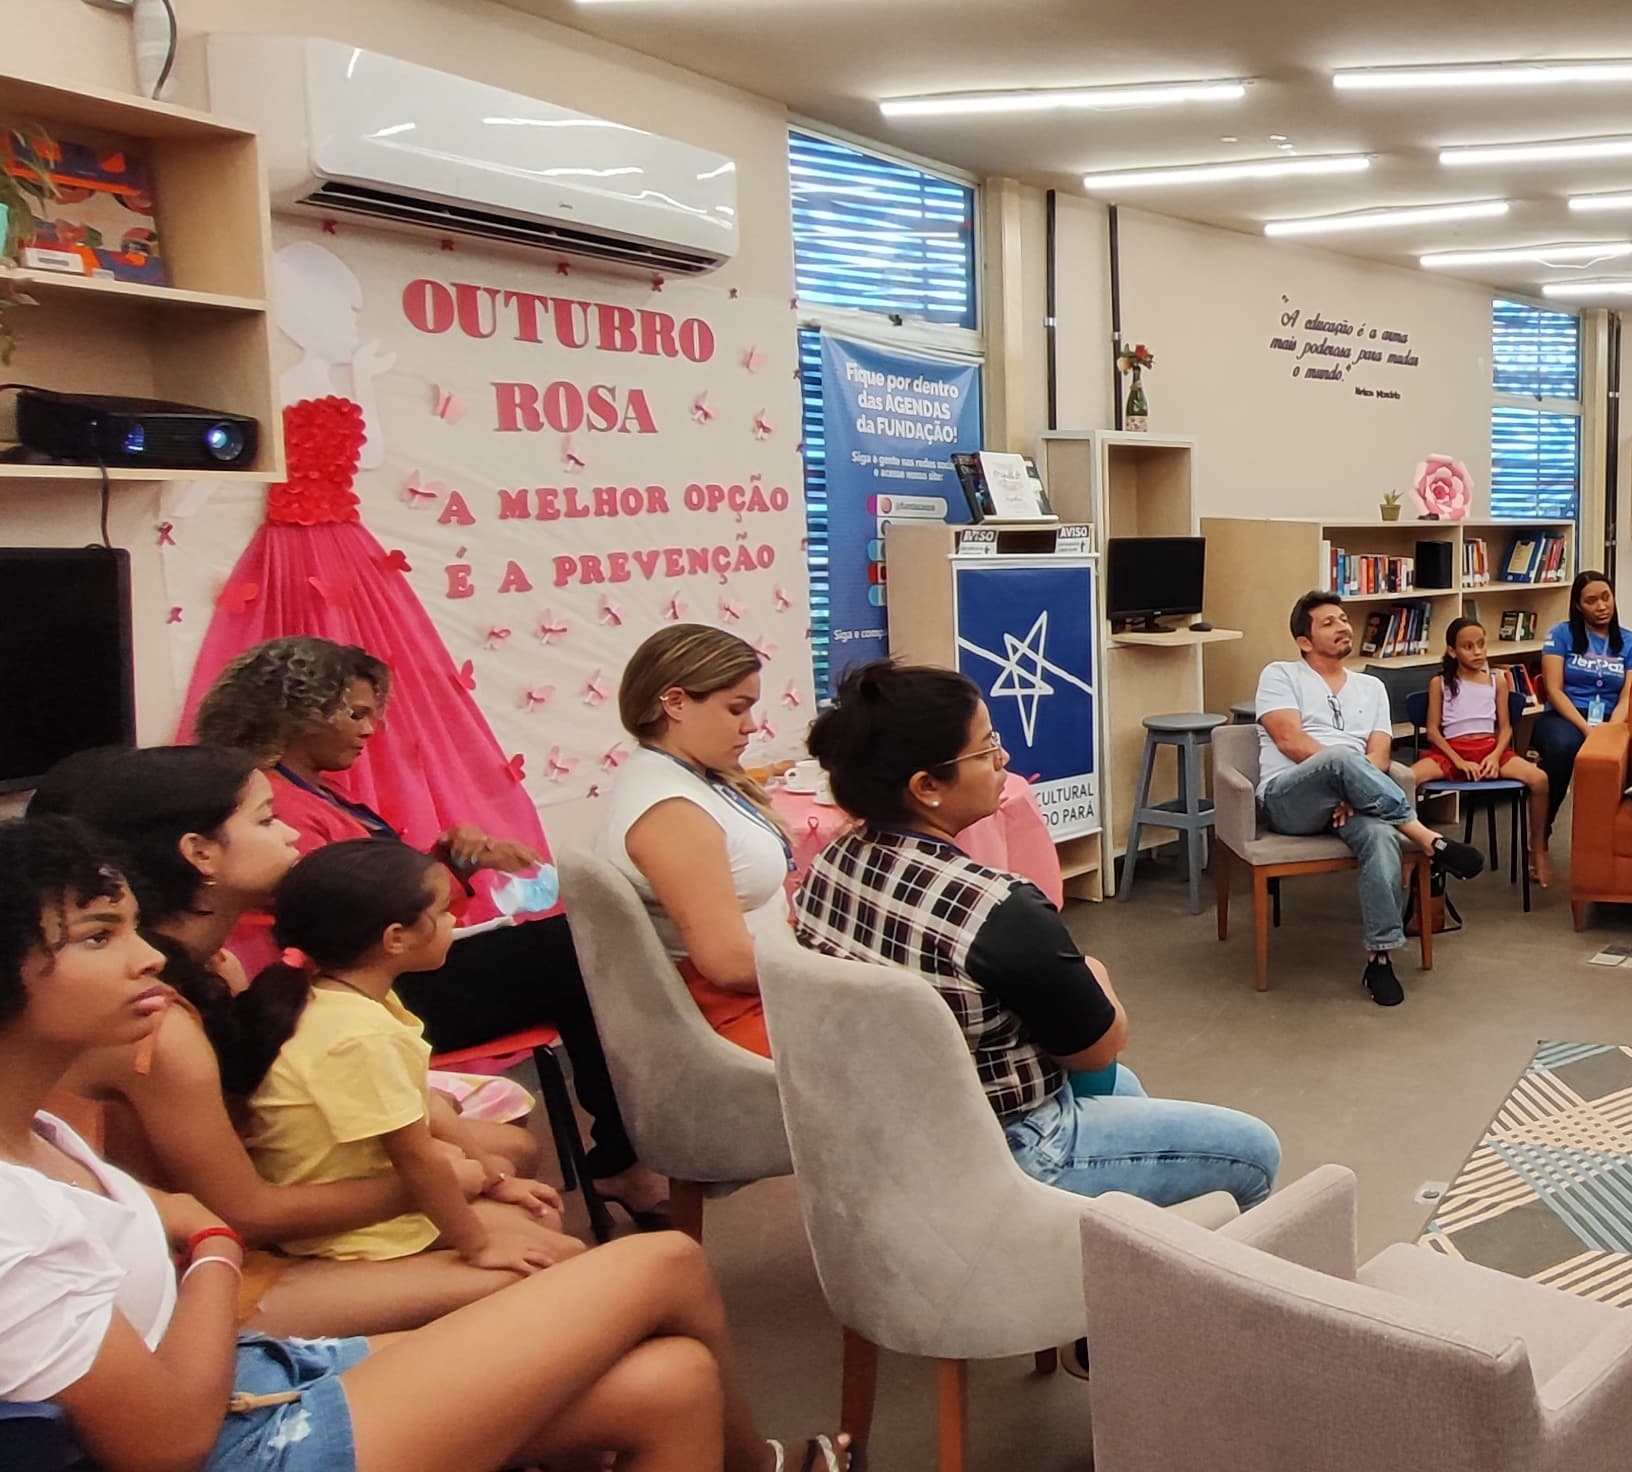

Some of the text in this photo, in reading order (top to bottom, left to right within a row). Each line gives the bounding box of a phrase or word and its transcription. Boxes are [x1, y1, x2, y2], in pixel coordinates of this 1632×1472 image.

[402, 278, 715, 363] OUTUBRO
[1369, 328, 1378, 339] a
[1269, 336, 1297, 351] mais
[1296, 337, 1352, 360] poderosa
[1352, 349, 1383, 365] para
[845, 361, 960, 399] Fique por dentro
[1292, 365, 1301, 378] o
[490, 380, 659, 435] ROSA
[857, 390, 951, 420] das AGENDAS
[856, 414, 958, 445] da FUNDAÇÃO!
[851, 450, 872, 466] Siga
[437, 473, 790, 526] A MELHOR OPÇÃO
[1059, 526, 1089, 538] AVISO
[444, 532, 776, 600] É A PREVENÇÃO
[833, 629, 853, 643] Siga
[1035, 782, 1095, 808] CULTURAL
[1062, 800, 1095, 824] PARÁ
